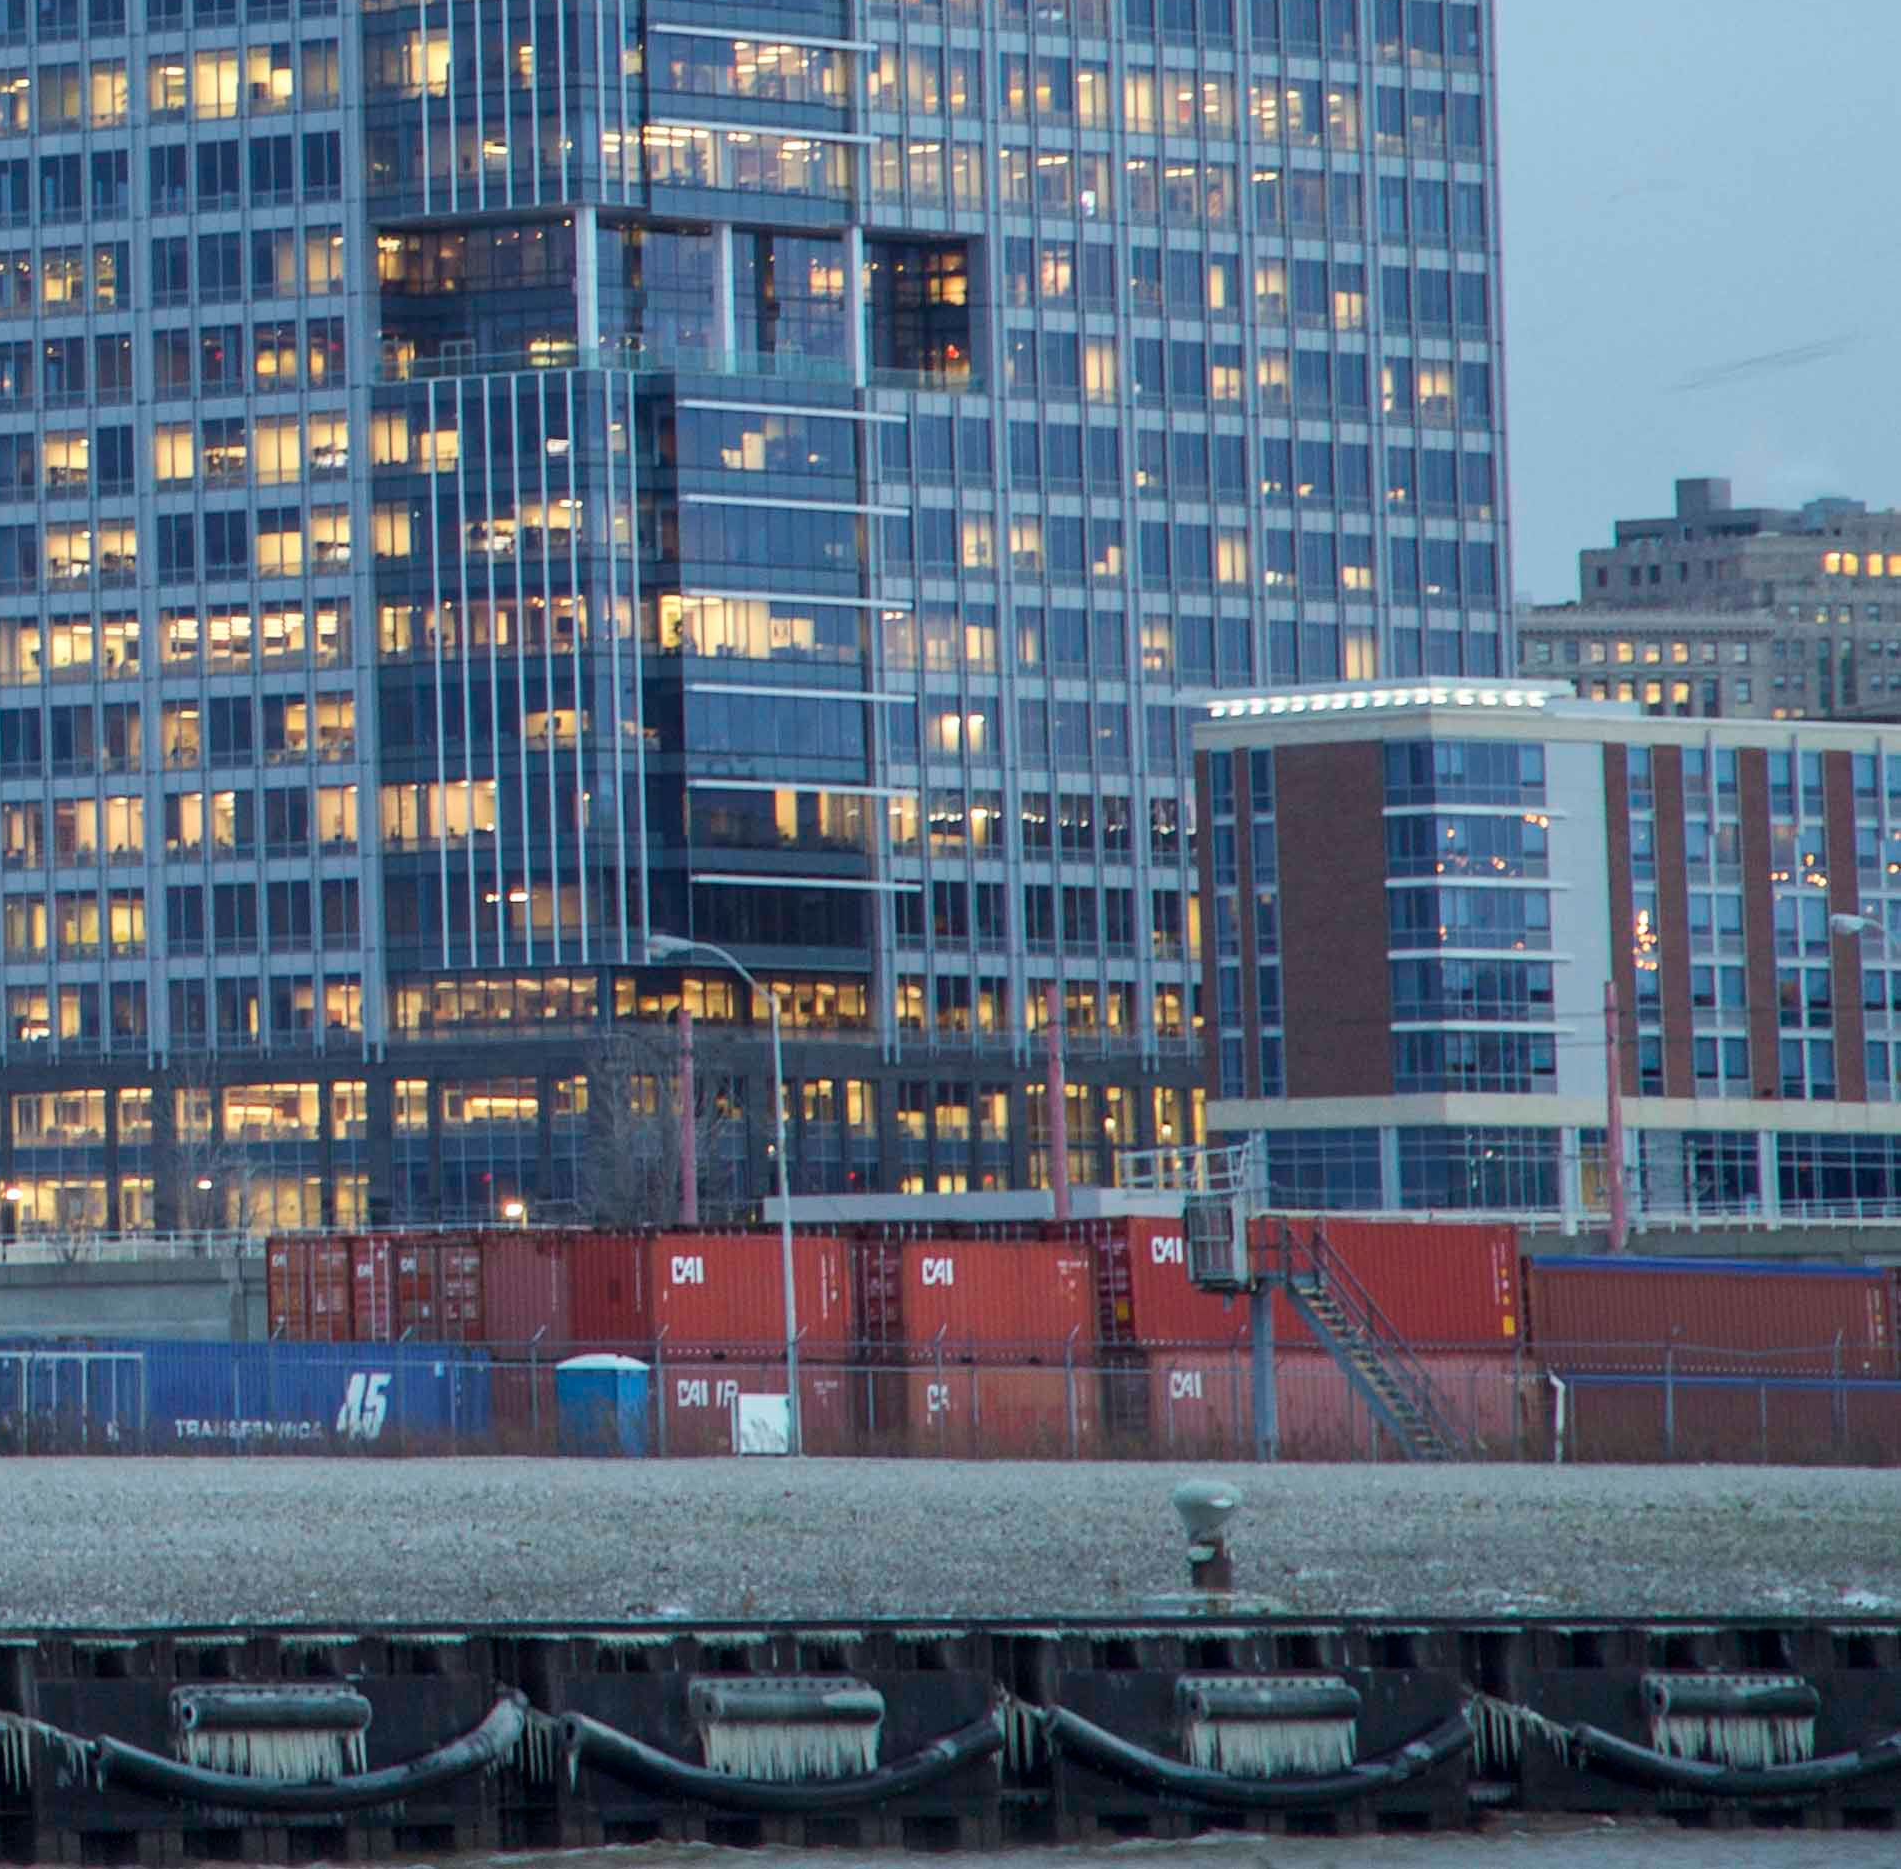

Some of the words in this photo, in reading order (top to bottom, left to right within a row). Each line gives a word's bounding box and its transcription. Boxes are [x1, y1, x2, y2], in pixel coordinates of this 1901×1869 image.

[1151, 1236, 1184, 1264] CAI
[671, 1255, 705, 1284] CAI
[921, 1257, 955, 1286] CAI
[1169, 1370, 1203, 1399] CAI
